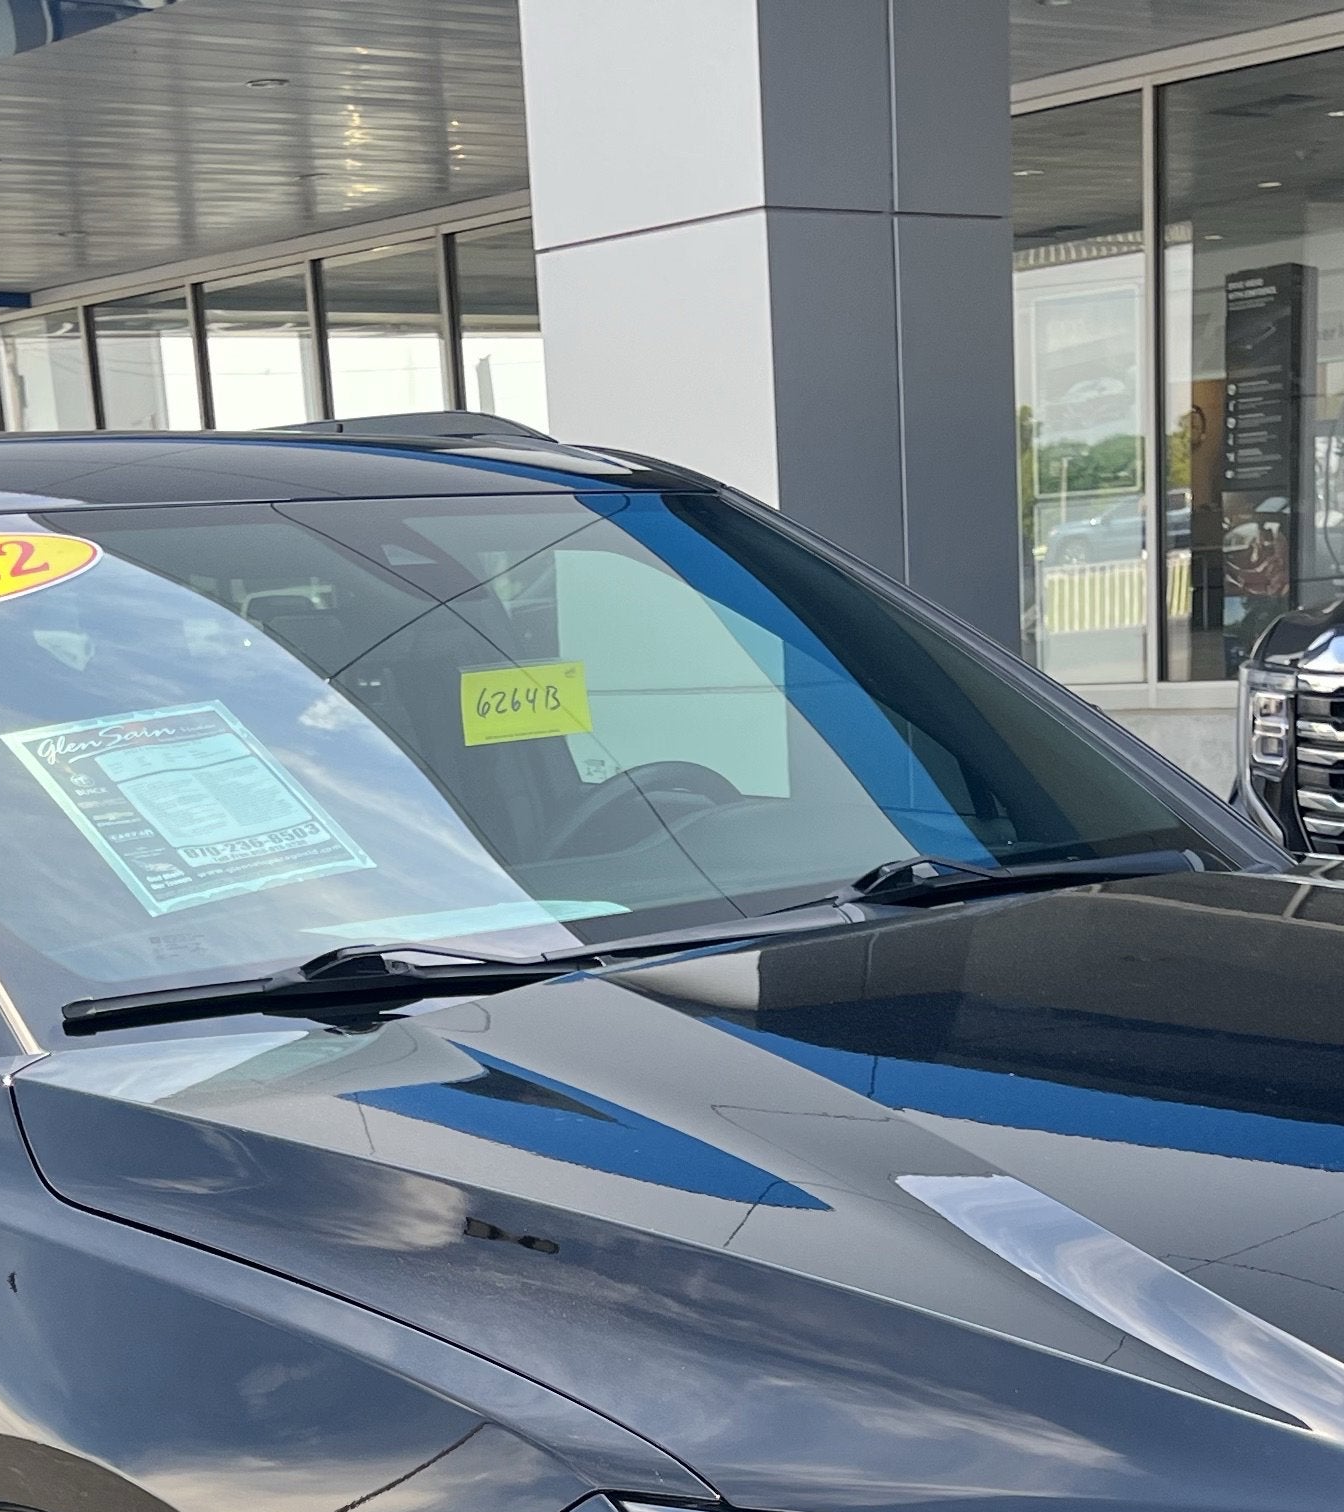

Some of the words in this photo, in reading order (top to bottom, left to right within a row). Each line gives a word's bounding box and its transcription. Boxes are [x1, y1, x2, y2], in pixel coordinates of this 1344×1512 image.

[476, 686, 561, 718] 6264B
[37, 735, 103, 766] Glen
[98, 726, 176, 748] Sain
